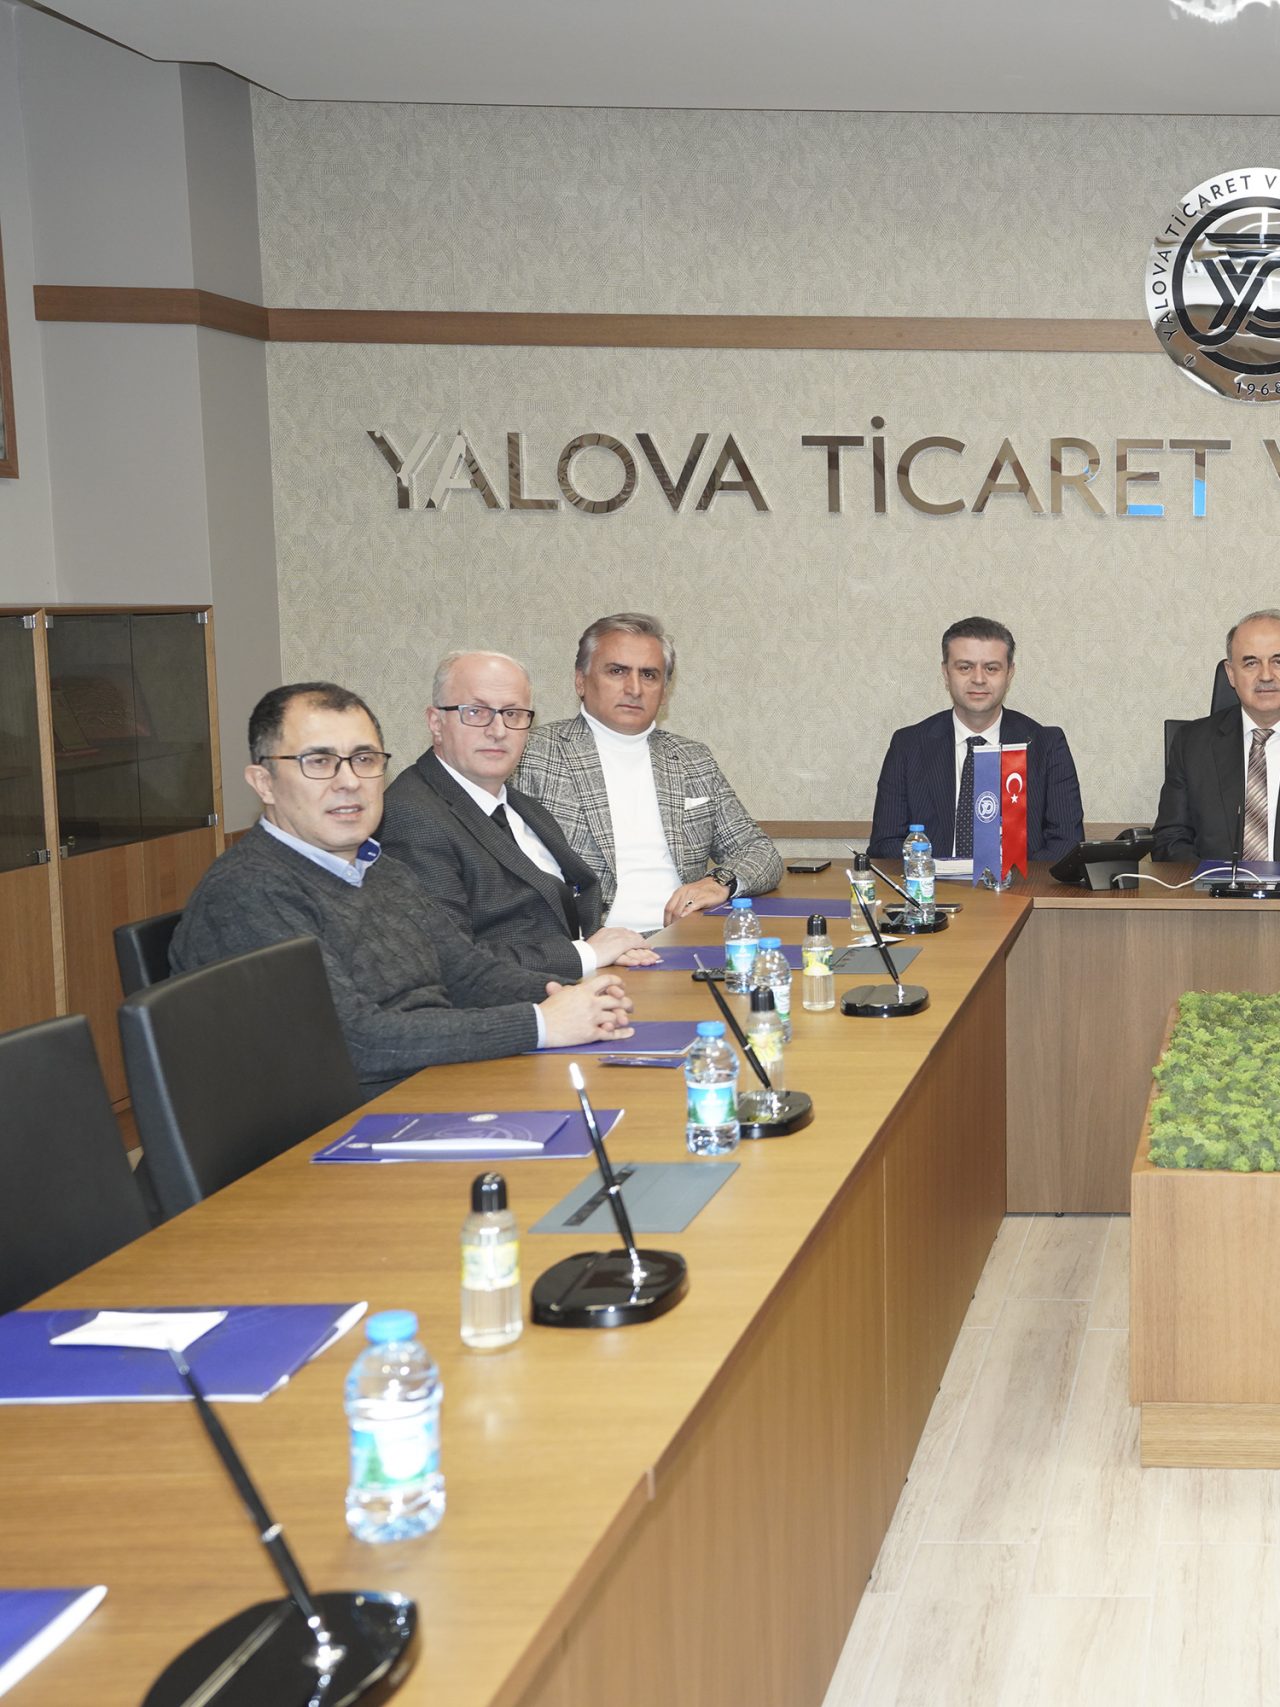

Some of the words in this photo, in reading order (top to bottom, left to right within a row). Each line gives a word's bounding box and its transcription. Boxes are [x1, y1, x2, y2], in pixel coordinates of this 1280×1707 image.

[1164, 174, 1252, 238] TİCARET
[1151, 249, 1178, 342] YALOVA
[366, 428, 772, 514] YALOVA
[801, 415, 1233, 517] TİCARET
